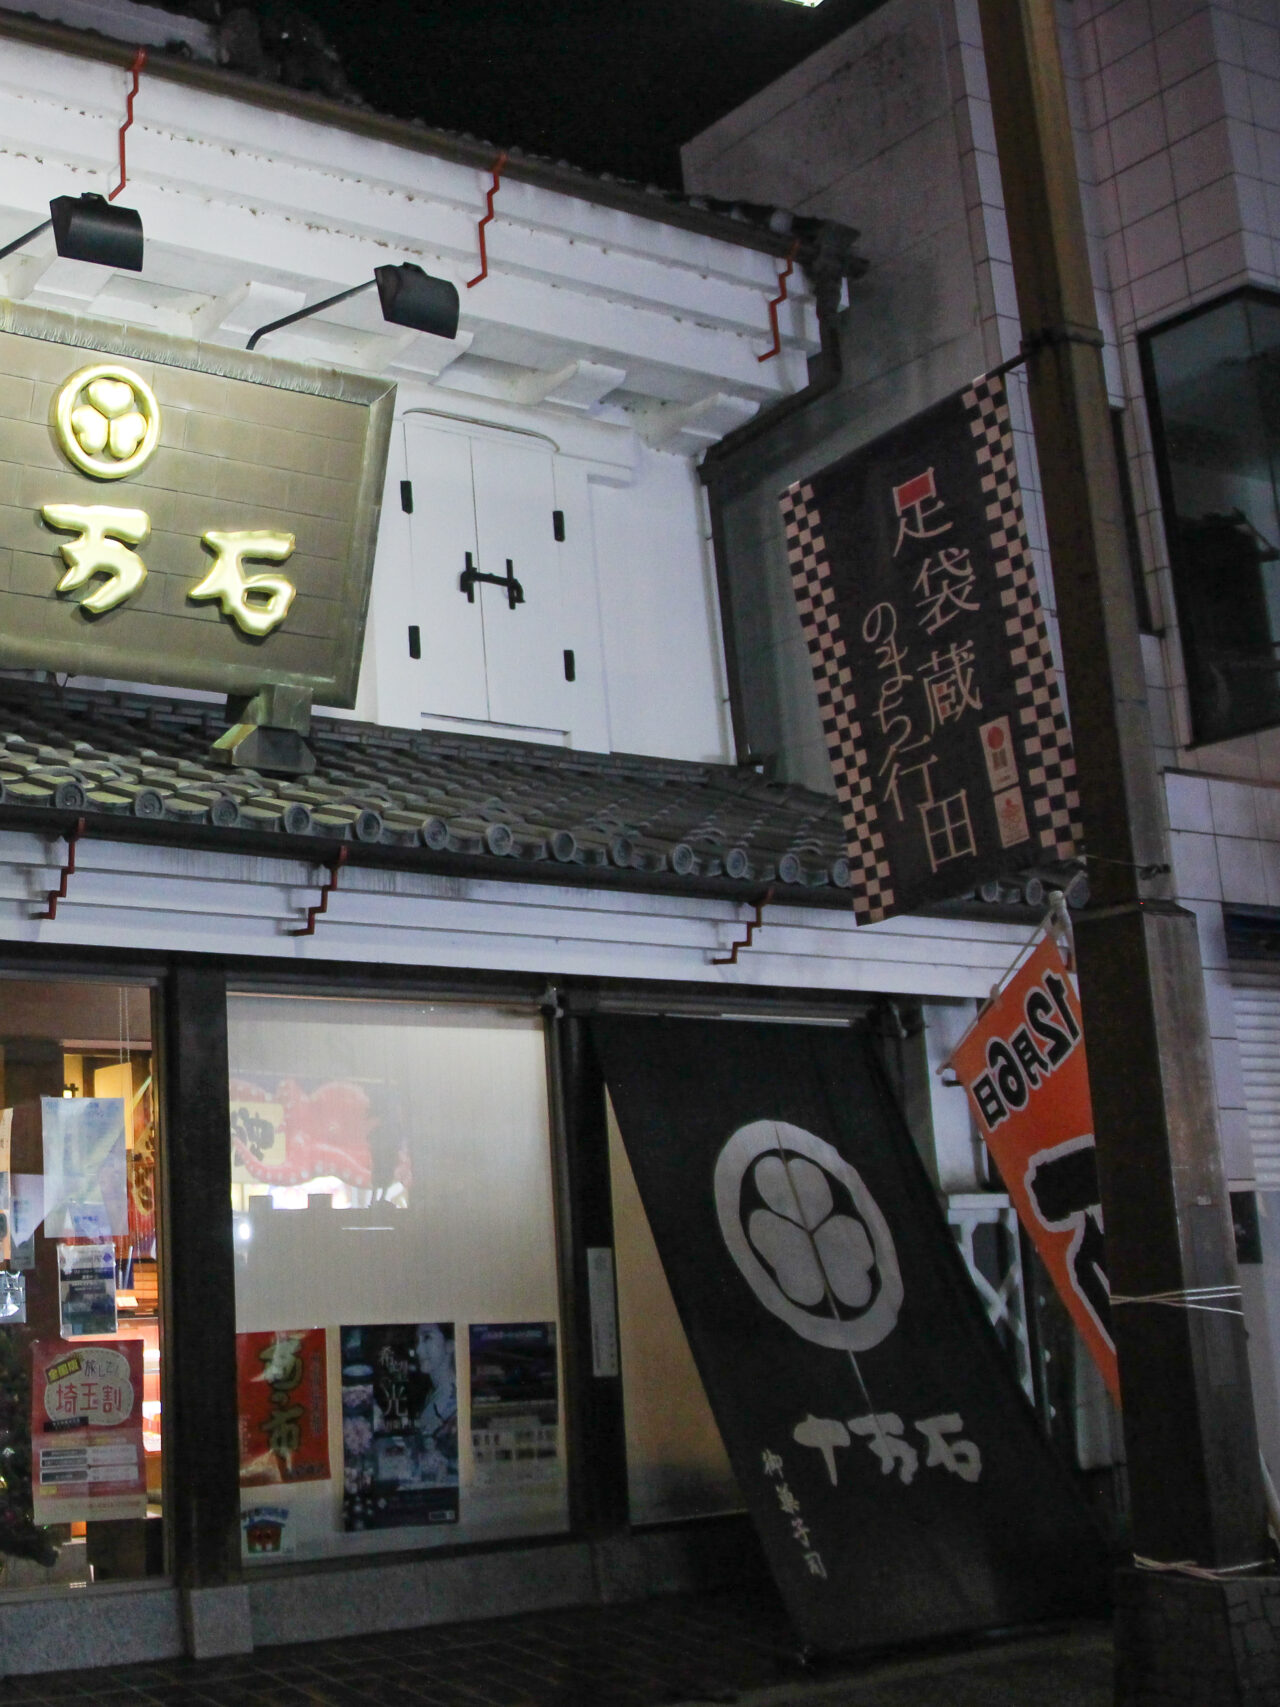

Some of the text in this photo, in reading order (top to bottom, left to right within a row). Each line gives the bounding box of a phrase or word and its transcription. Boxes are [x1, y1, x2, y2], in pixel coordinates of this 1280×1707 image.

[892, 466, 983, 735] 足袋蔵
[862, 601, 978, 874] のまち行田
[55, 1382, 121, 1415] 埼玉割
[793, 1412, 982, 1488] 十万石
